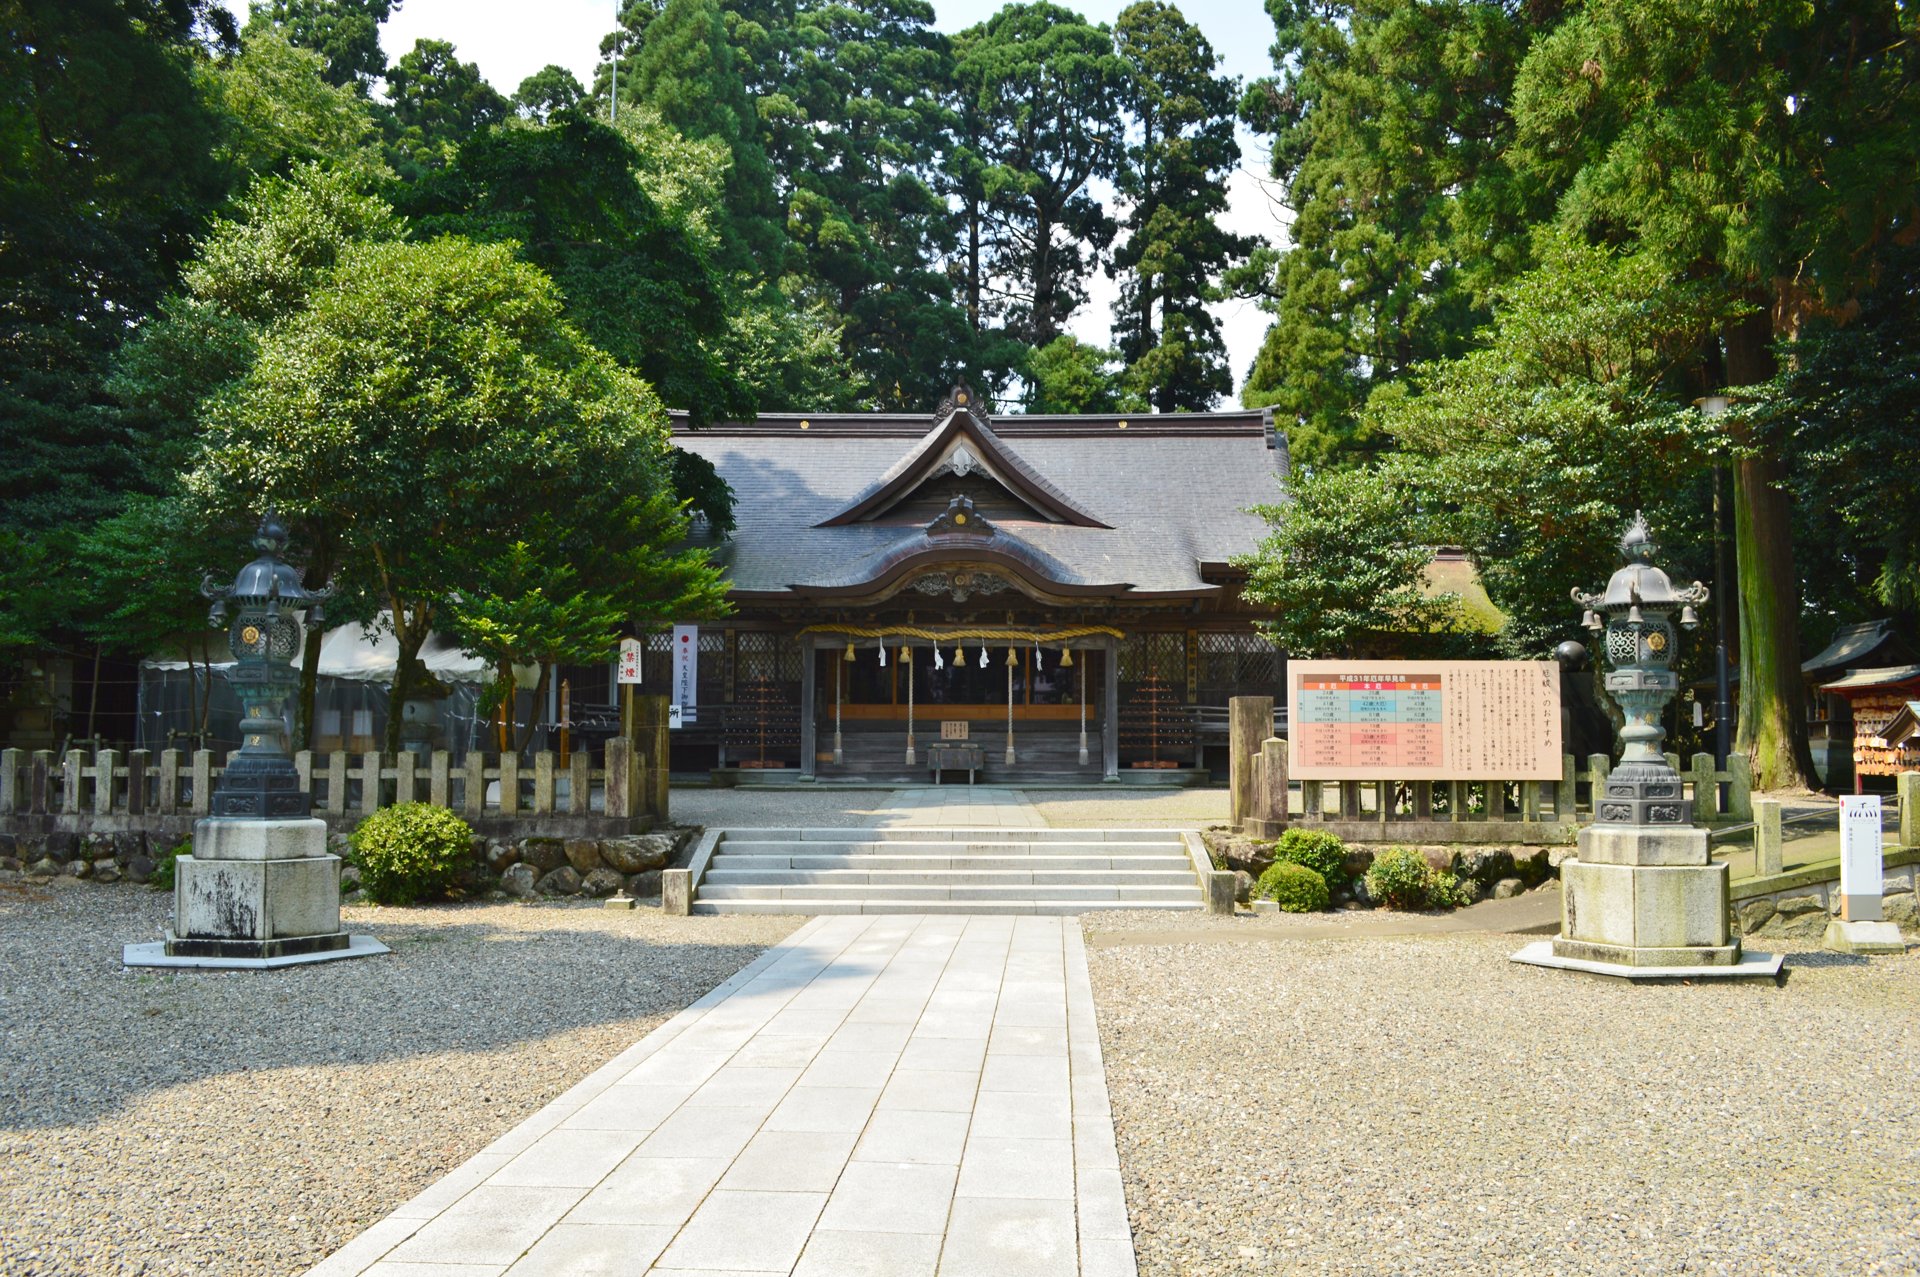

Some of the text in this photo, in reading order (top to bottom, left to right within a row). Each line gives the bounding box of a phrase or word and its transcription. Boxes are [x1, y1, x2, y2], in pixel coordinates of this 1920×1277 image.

[626, 652, 635, 678] 禁煙
[1340, 675, 1406, 683] 平成31年厄年早見表
